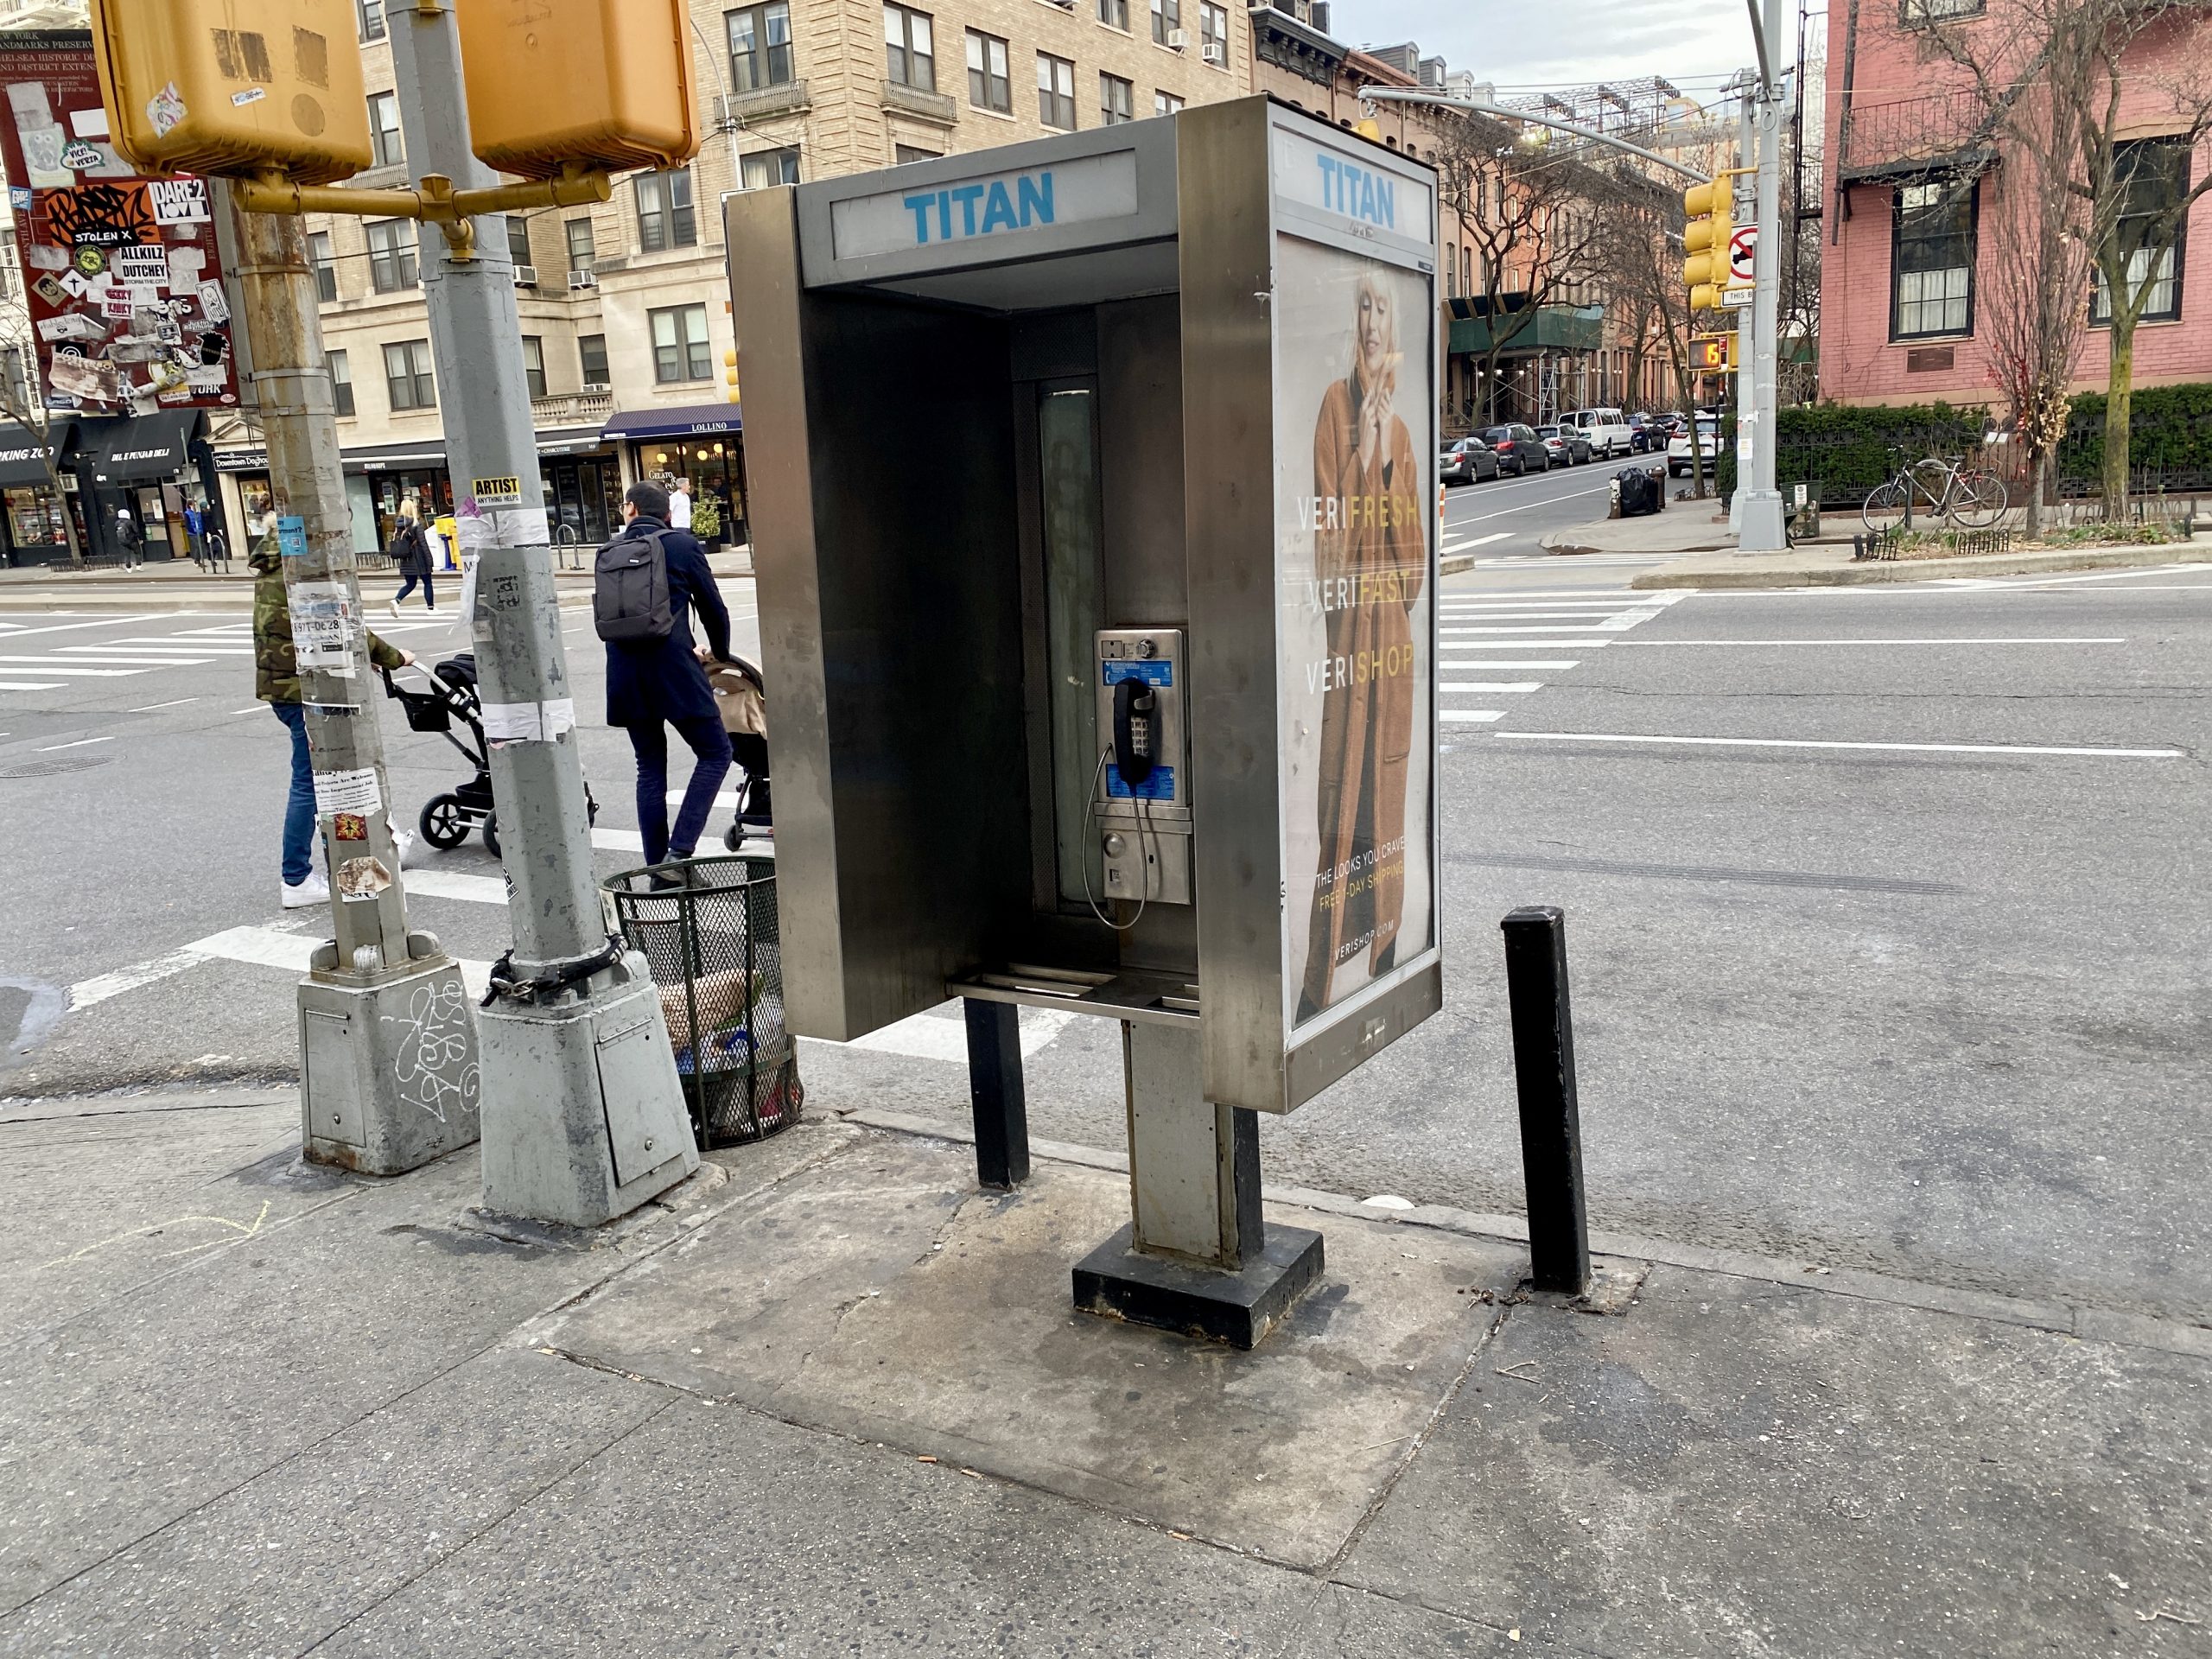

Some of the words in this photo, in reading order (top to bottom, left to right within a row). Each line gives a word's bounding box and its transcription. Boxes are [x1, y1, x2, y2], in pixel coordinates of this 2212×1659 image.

[69, 148, 87, 158] VICE!
[904, 171, 1054, 244] TITAN
[1317, 153, 1395, 230] TITAN
[121, 247, 164, 259] ALLKILZ
[123, 264, 165, 276] DUTCHEY
[1731, 291, 1745, 300] THIS
[691, 422, 728, 432] LOLLINO
[215, 459, 246, 467] Downtown
[476, 479, 517, 495] ARTIST
[1297, 494, 1420, 531] VERIFRESH
[1308, 571, 1412, 613] VERIFAST
[1306, 643, 1414, 695] VERISHOP
[1316, 868, 1332, 888] THE
[1334, 855, 1361, 880] LOOKS
[1363, 849, 1380, 867] YOU
[1382, 836, 1405, 859] CRAVE
[1319, 889, 1340, 912] FREE
[1367, 860, 1404, 889] SHIPPING
[1335, 918, 1394, 961] VERISHOP.COM
